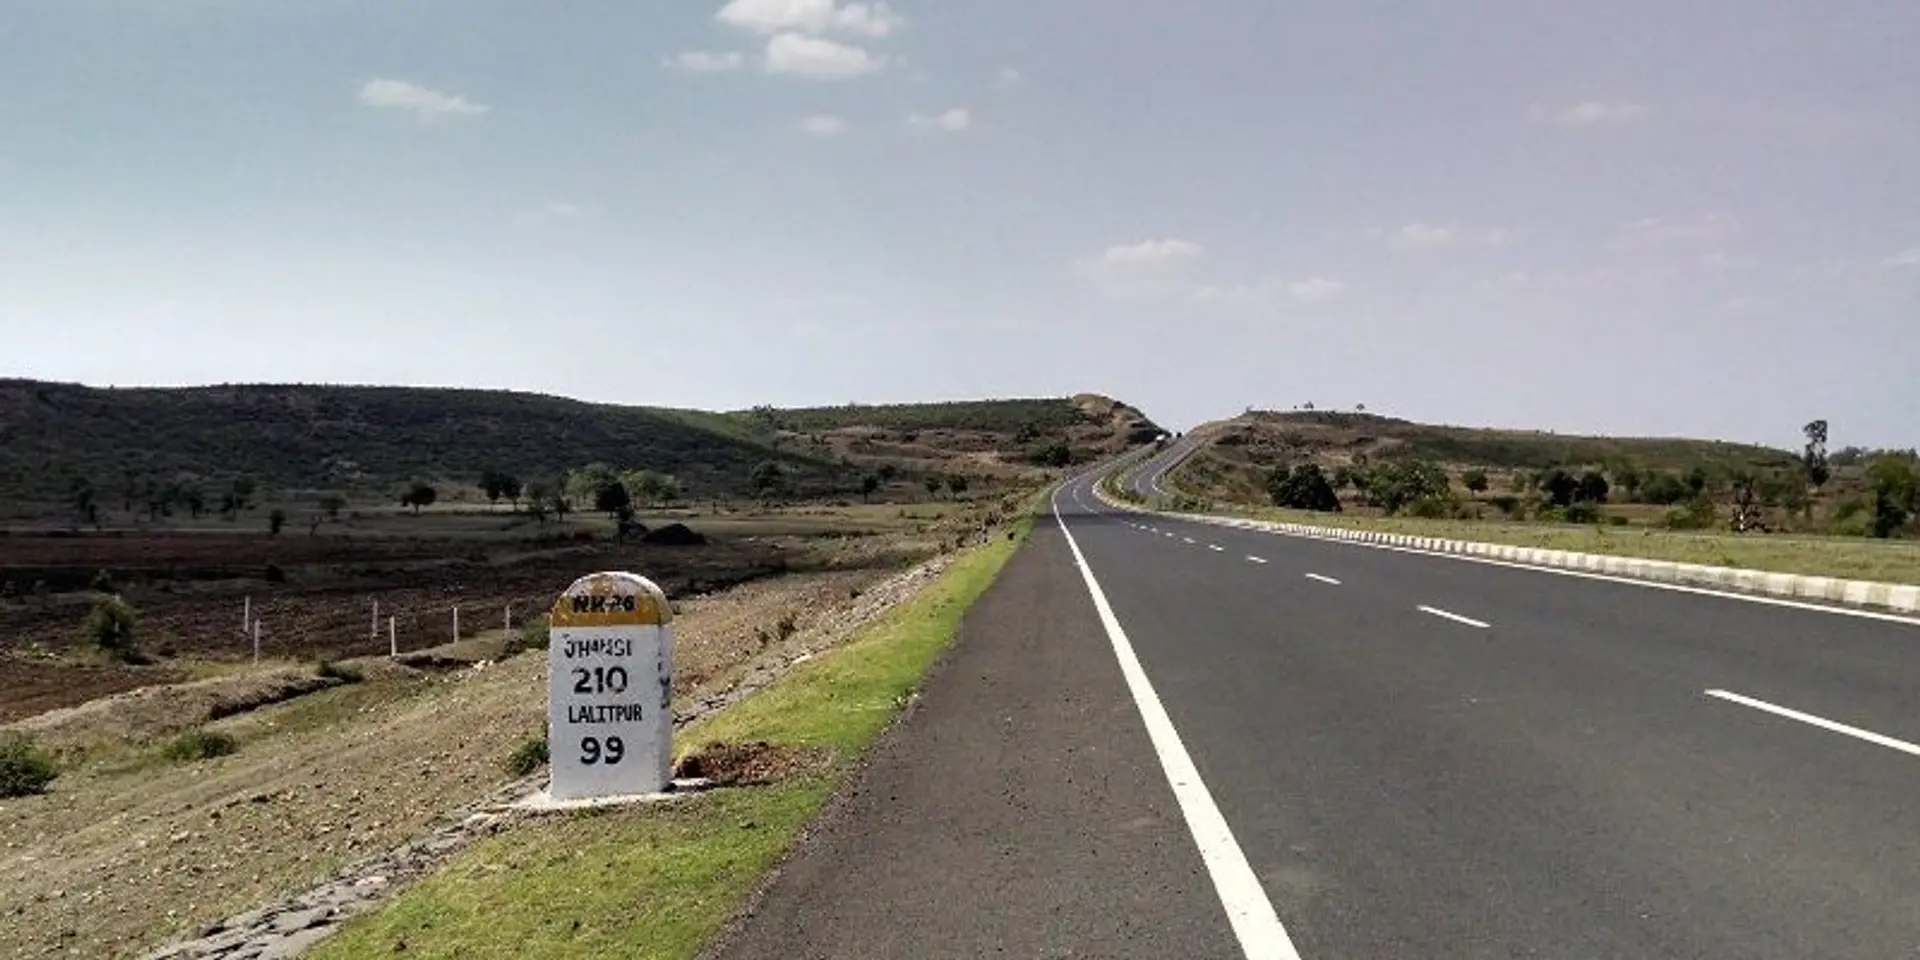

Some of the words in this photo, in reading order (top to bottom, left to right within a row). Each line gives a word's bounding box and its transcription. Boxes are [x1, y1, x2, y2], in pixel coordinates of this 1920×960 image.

[564, 638, 632, 659] JHANSI
[571, 666, 628, 694] 210
[568, 704, 642, 723] LALITPUR
[580, 736, 624, 765] 99
